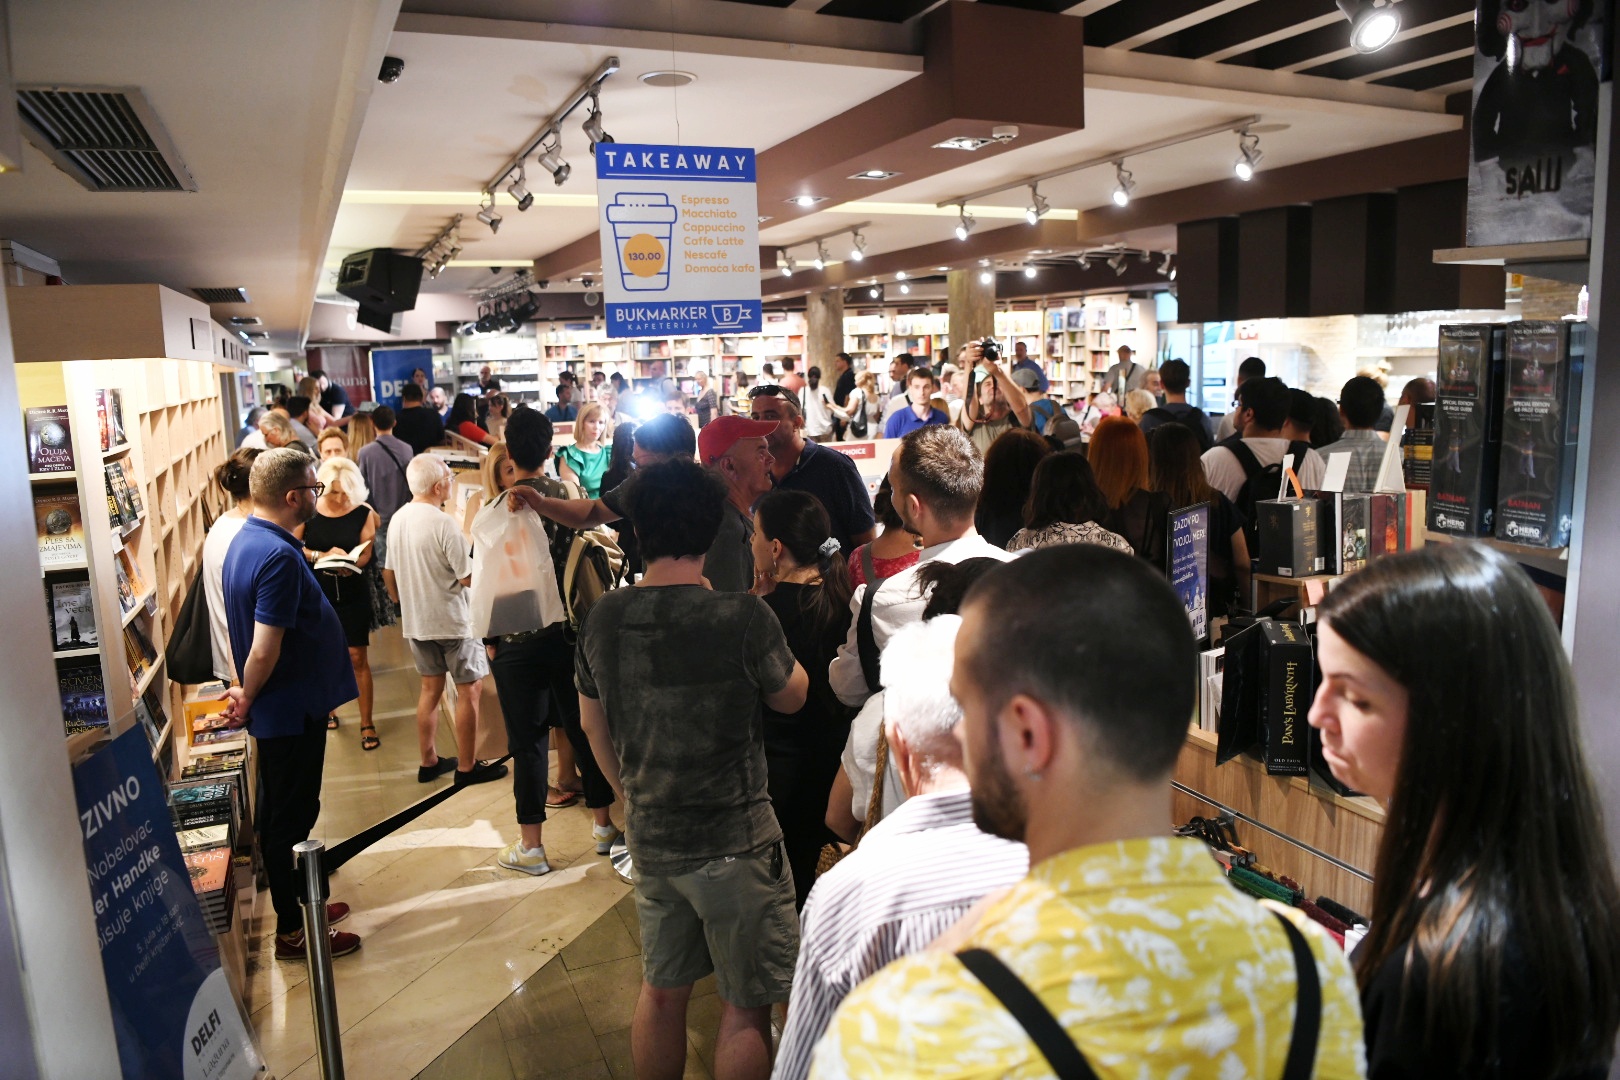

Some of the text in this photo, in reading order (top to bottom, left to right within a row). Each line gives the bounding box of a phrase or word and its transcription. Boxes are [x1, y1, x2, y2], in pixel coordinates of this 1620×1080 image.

[604, 151, 746, 171] TAKEAWAY
[1506, 156, 1562, 197] SAW
[681, 194, 730, 206] Espresso
[682, 208, 738, 219] Macchiato
[683, 222, 746, 234] Cappuccino
[684, 236, 744, 246] Caffe Latte
[628, 252, 662, 261] 130.00
[684, 250, 728, 260] Nescafé
[685, 263, 755, 273] Domaća kafa
[616, 306, 732, 322] BUKMARKER B
[628, 322, 698, 331] KAFETERIJA
[40, 448, 68, 456] OLUJA
[38, 455, 71, 463] MAČEVA
[1437, 492, 1466, 504] BATMAN
[1507, 498, 1542, 510] BATMAN
[1519, 526, 1540, 534] HERO
[45, 536, 63, 544] PLES
[1282, 660, 1298, 745] PAN'S LABYRINTH
[88, 820, 153, 886] Nobelovac
[94, 845, 160, 916] er Handke
[132, 870, 169, 912] knjige
[190, 1008, 221, 1056] DELFI
[202, 1038, 230, 1078] Laguna
